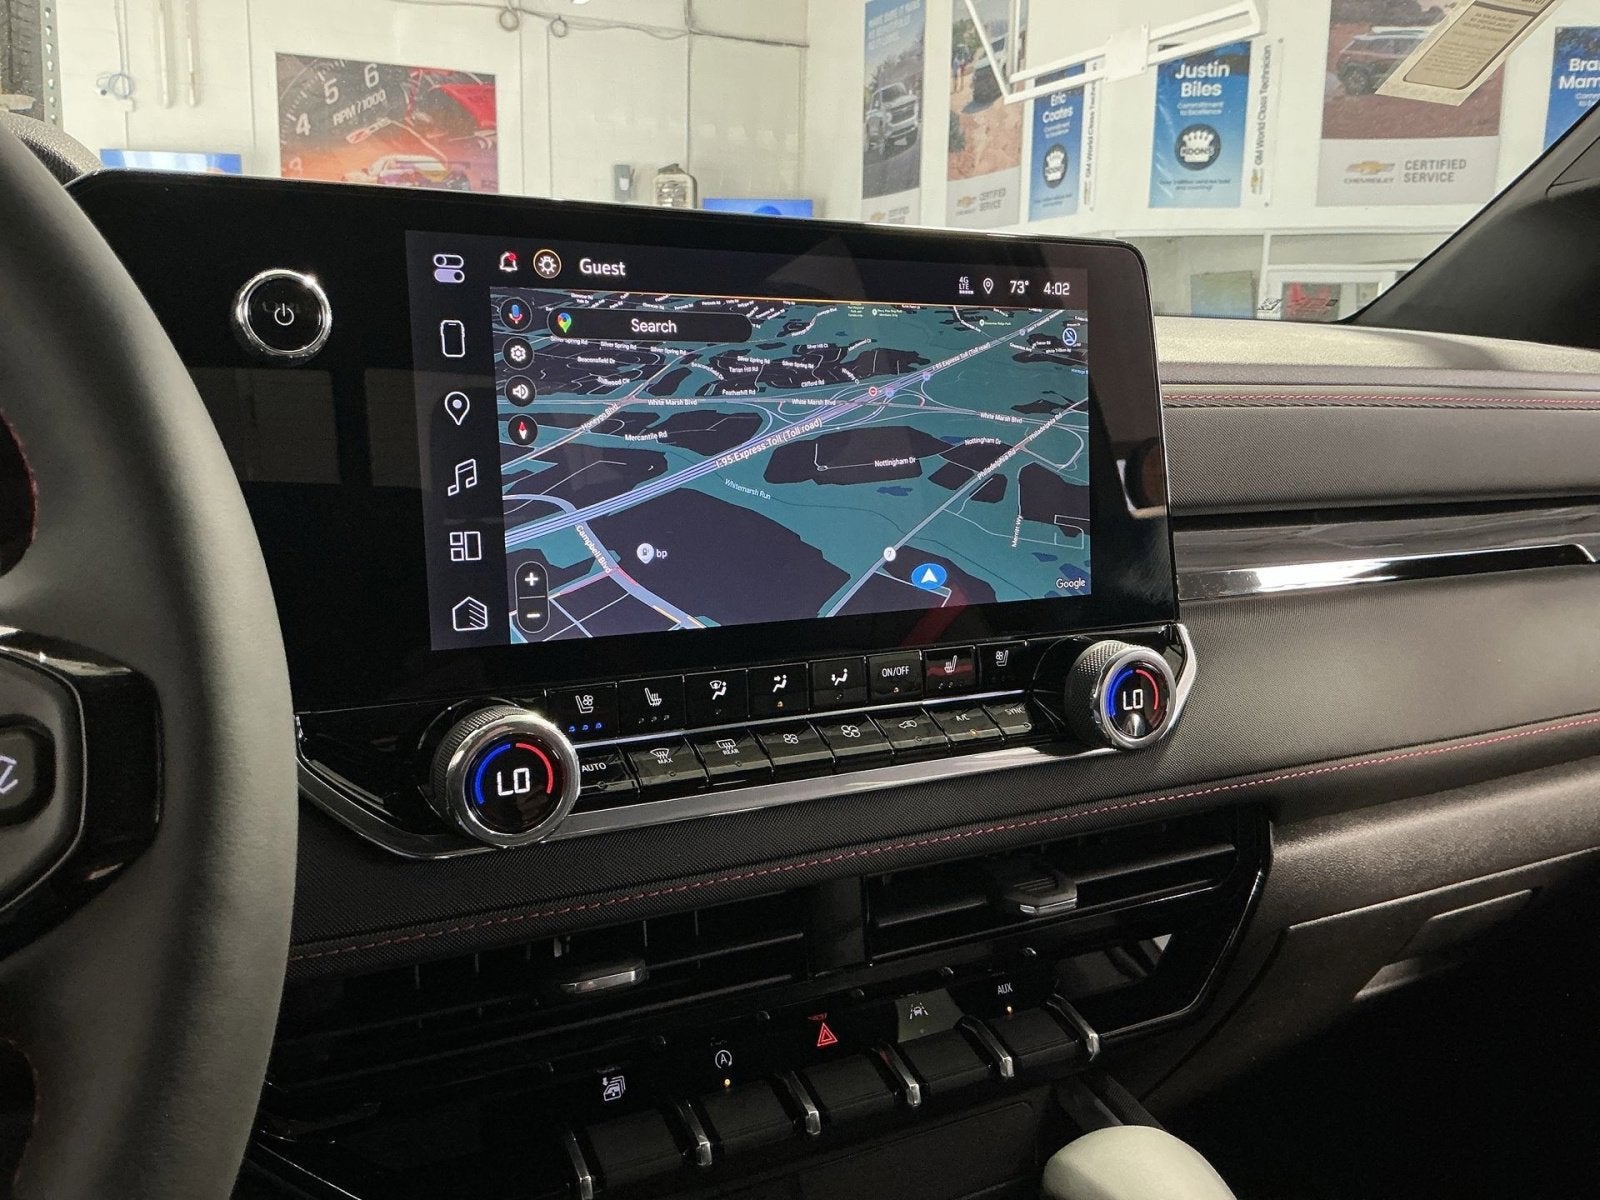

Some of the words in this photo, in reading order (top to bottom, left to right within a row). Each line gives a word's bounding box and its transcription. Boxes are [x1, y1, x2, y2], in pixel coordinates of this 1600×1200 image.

[1174, 60, 1231, 79] Justin
[1568, 58, 1600, 72] Bra
[364, 63, 379, 88] 6
[323, 77, 339, 105] 5
[1180, 81, 1223, 98] Biles
[296, 112, 311, 136] 4
[1404, 159, 1467, 171] CERTIFIED
[1403, 171, 1456, 184] SERVICE
[579, 257, 626, 277] Guest
[1009, 279, 1030, 294] 73°
[1043, 281, 1071, 295] 4:02
[631, 317, 678, 334] Search
[807, 398, 824, 406] Marsh
[604, 403, 619, 417] Blvd
[1055, 412, 1064, 422] Rd
[980, 412, 995, 420] White
[996, 414, 1011, 422] Marsh
[1011, 416, 1023, 424] Blvd
[624, 432, 657, 441] Mercantile
[658, 430, 668, 438] Rd
[733, 440, 768, 461] Express
[767, 436, 782, 447] Toll
[782, 426, 802, 442] (Toll
[801, 416, 823, 434] road)
[964, 436, 994, 446] Nottingham
[874, 457, 908, 468] Nottingham
[977, 453, 1010, 481] Philadelphia
[725, 478, 759, 497] Whitemarsh
[759, 489, 771, 500] Run
[575, 525, 601, 559] Campbell
[599, 555, 612, 573] Blvd
[655, 548, 668, 560] bp
[1056, 577, 1086, 590] Google
[881, 665, 910, 678] ON/OFF
[1123, 688, 1143, 711] LO
[1004, 704, 1026, 716] SYNC
[955, 713, 971, 722] A/C
[722, 748, 740, 756] REAR
[581, 762, 607, 773] AUTO
[656, 757, 673, 765] MAX
[496, 767, 531, 797] LO
[997, 982, 1013, 996] AUX
